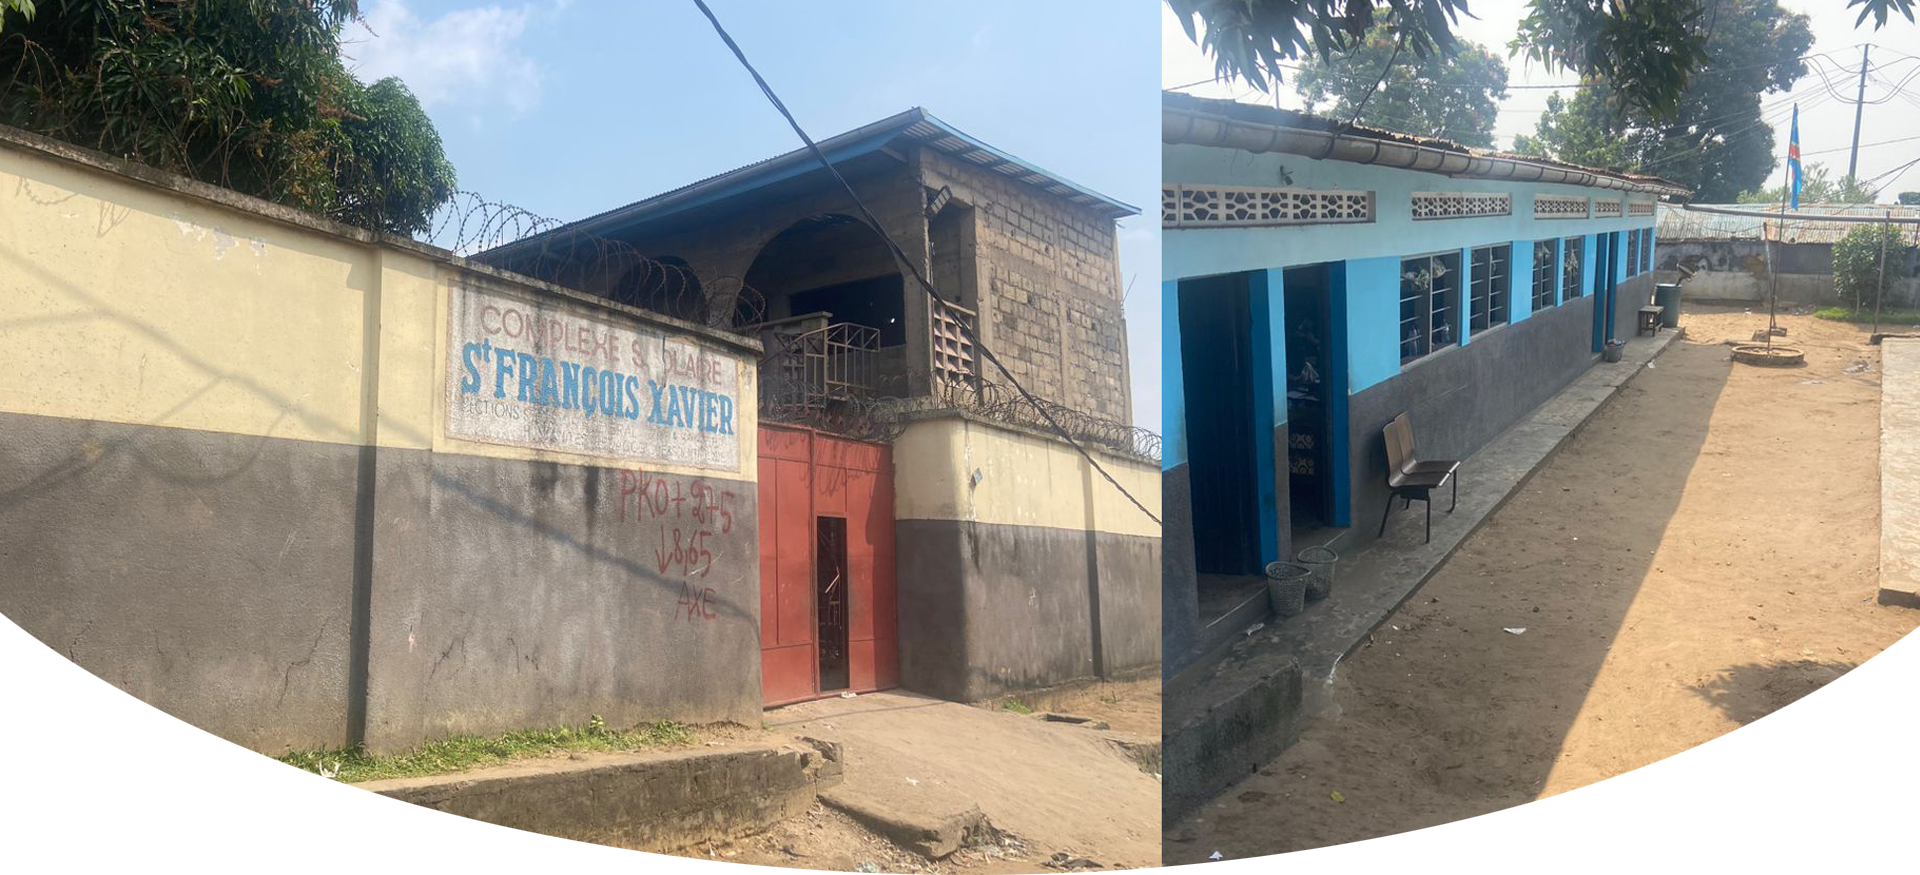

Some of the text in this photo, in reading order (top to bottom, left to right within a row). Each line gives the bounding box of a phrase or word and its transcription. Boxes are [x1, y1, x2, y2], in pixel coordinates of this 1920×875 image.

[480, 305, 722, 385] COMPLEXE SOLAIRE
[494, 348, 640, 419] FRANÇOIS
[647, 379, 734, 435] XAVIER
[674, 580, 717, 622] AXE
